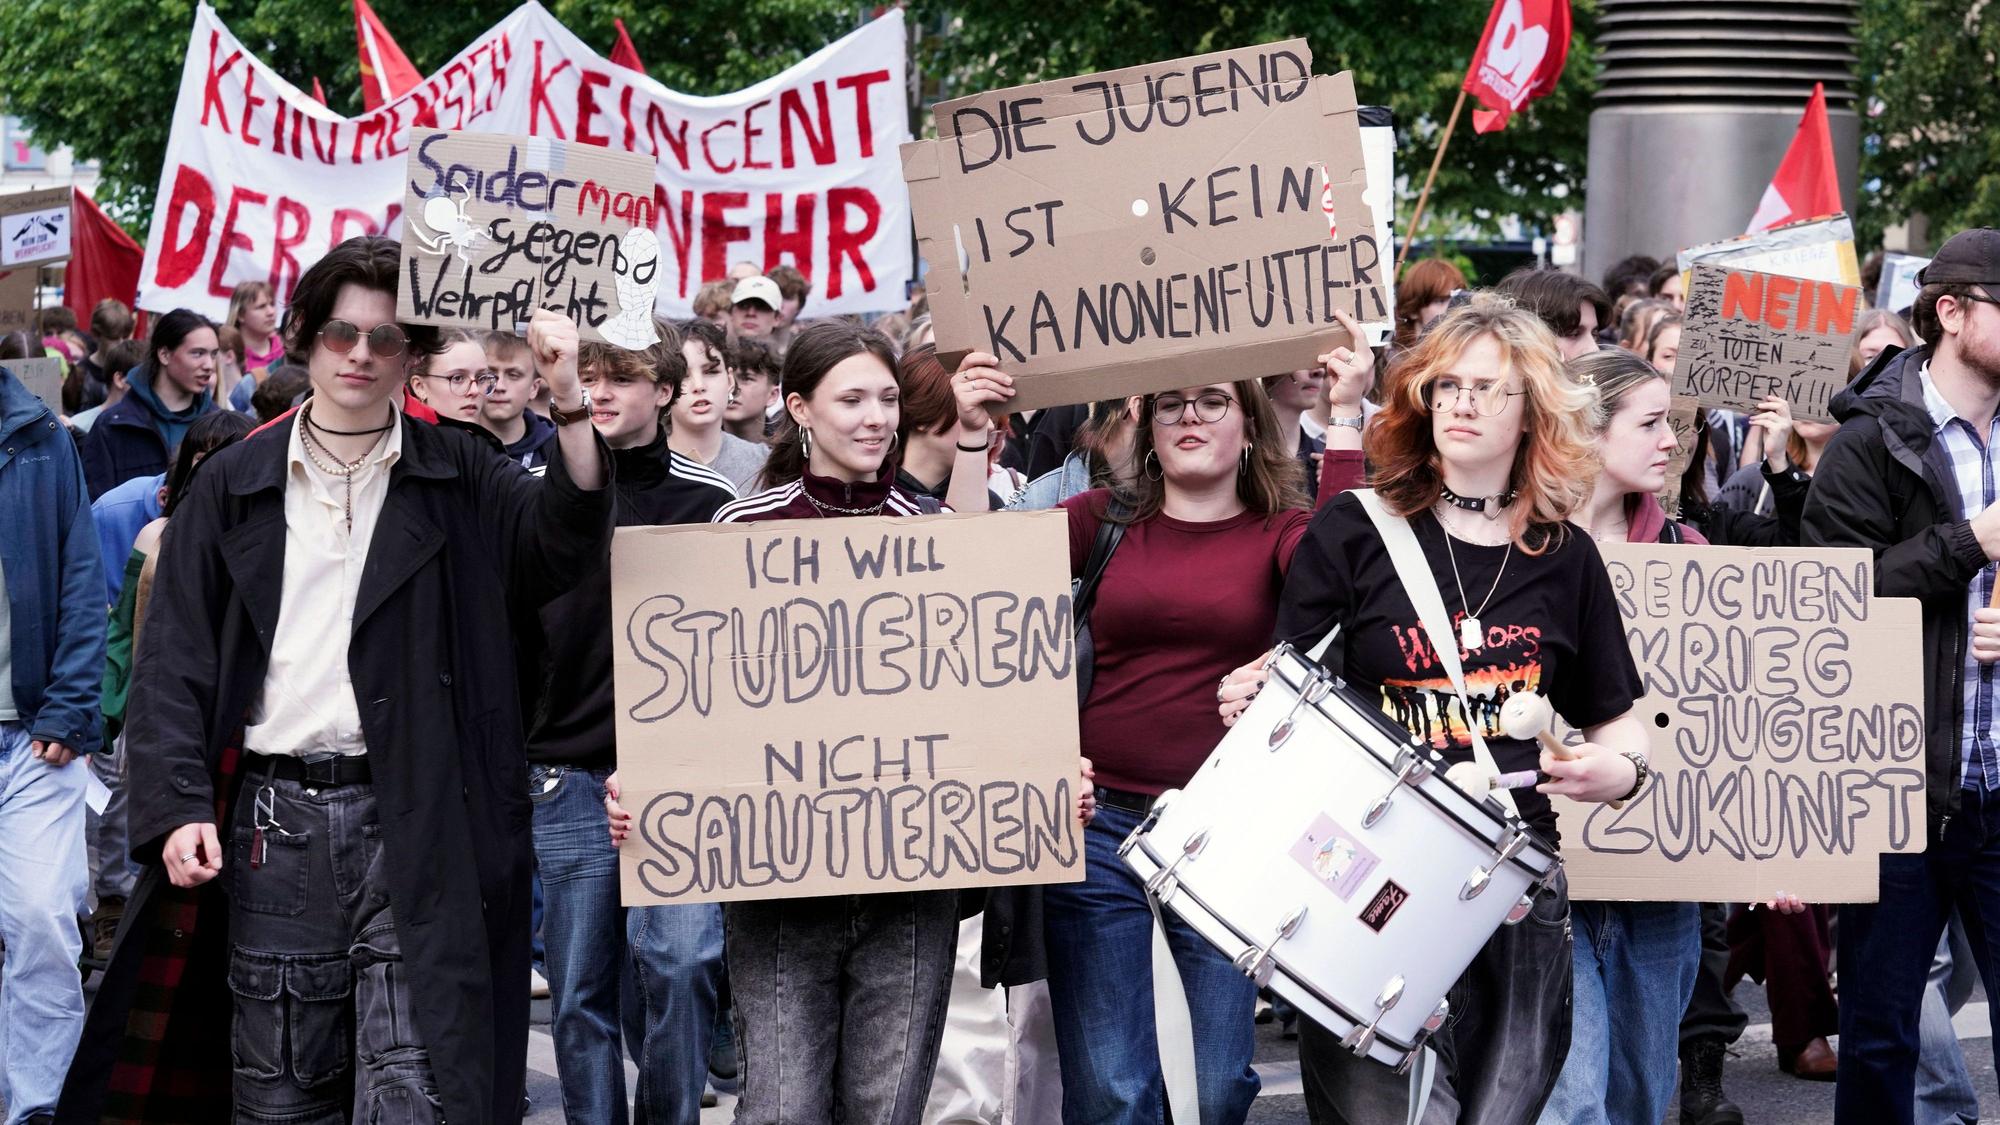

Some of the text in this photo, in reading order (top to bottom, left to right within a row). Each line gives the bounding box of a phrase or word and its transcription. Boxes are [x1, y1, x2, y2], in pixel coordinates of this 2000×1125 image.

[200, 29, 336, 165] KEIN
[530, 40, 890, 174] KEIN CENT
[953, 51, 1309, 174] DIE JUGEND
[411, 133, 577, 212] Spider
[975, 164, 1314, 263] IST KEIN
[155, 163, 311, 306] DER
[478, 218, 620, 287] gegen
[982, 234, 1387, 363] KANONENFUTTER
[1721, 271, 1858, 336] NEIN
[1718, 336, 1783, 364] TOTEN
[746, 534, 945, 588] ICH WILL
[626, 592, 1073, 723] STUDIEREN
[1627, 621, 1852, 698] KRIEG
[765, 732, 950, 788] NICHT
[1675, 694, 1924, 769] JUGEND
[637, 777, 1079, 898] SALUTIEREN
[1582, 764, 1925, 862] ZUKUNFT
